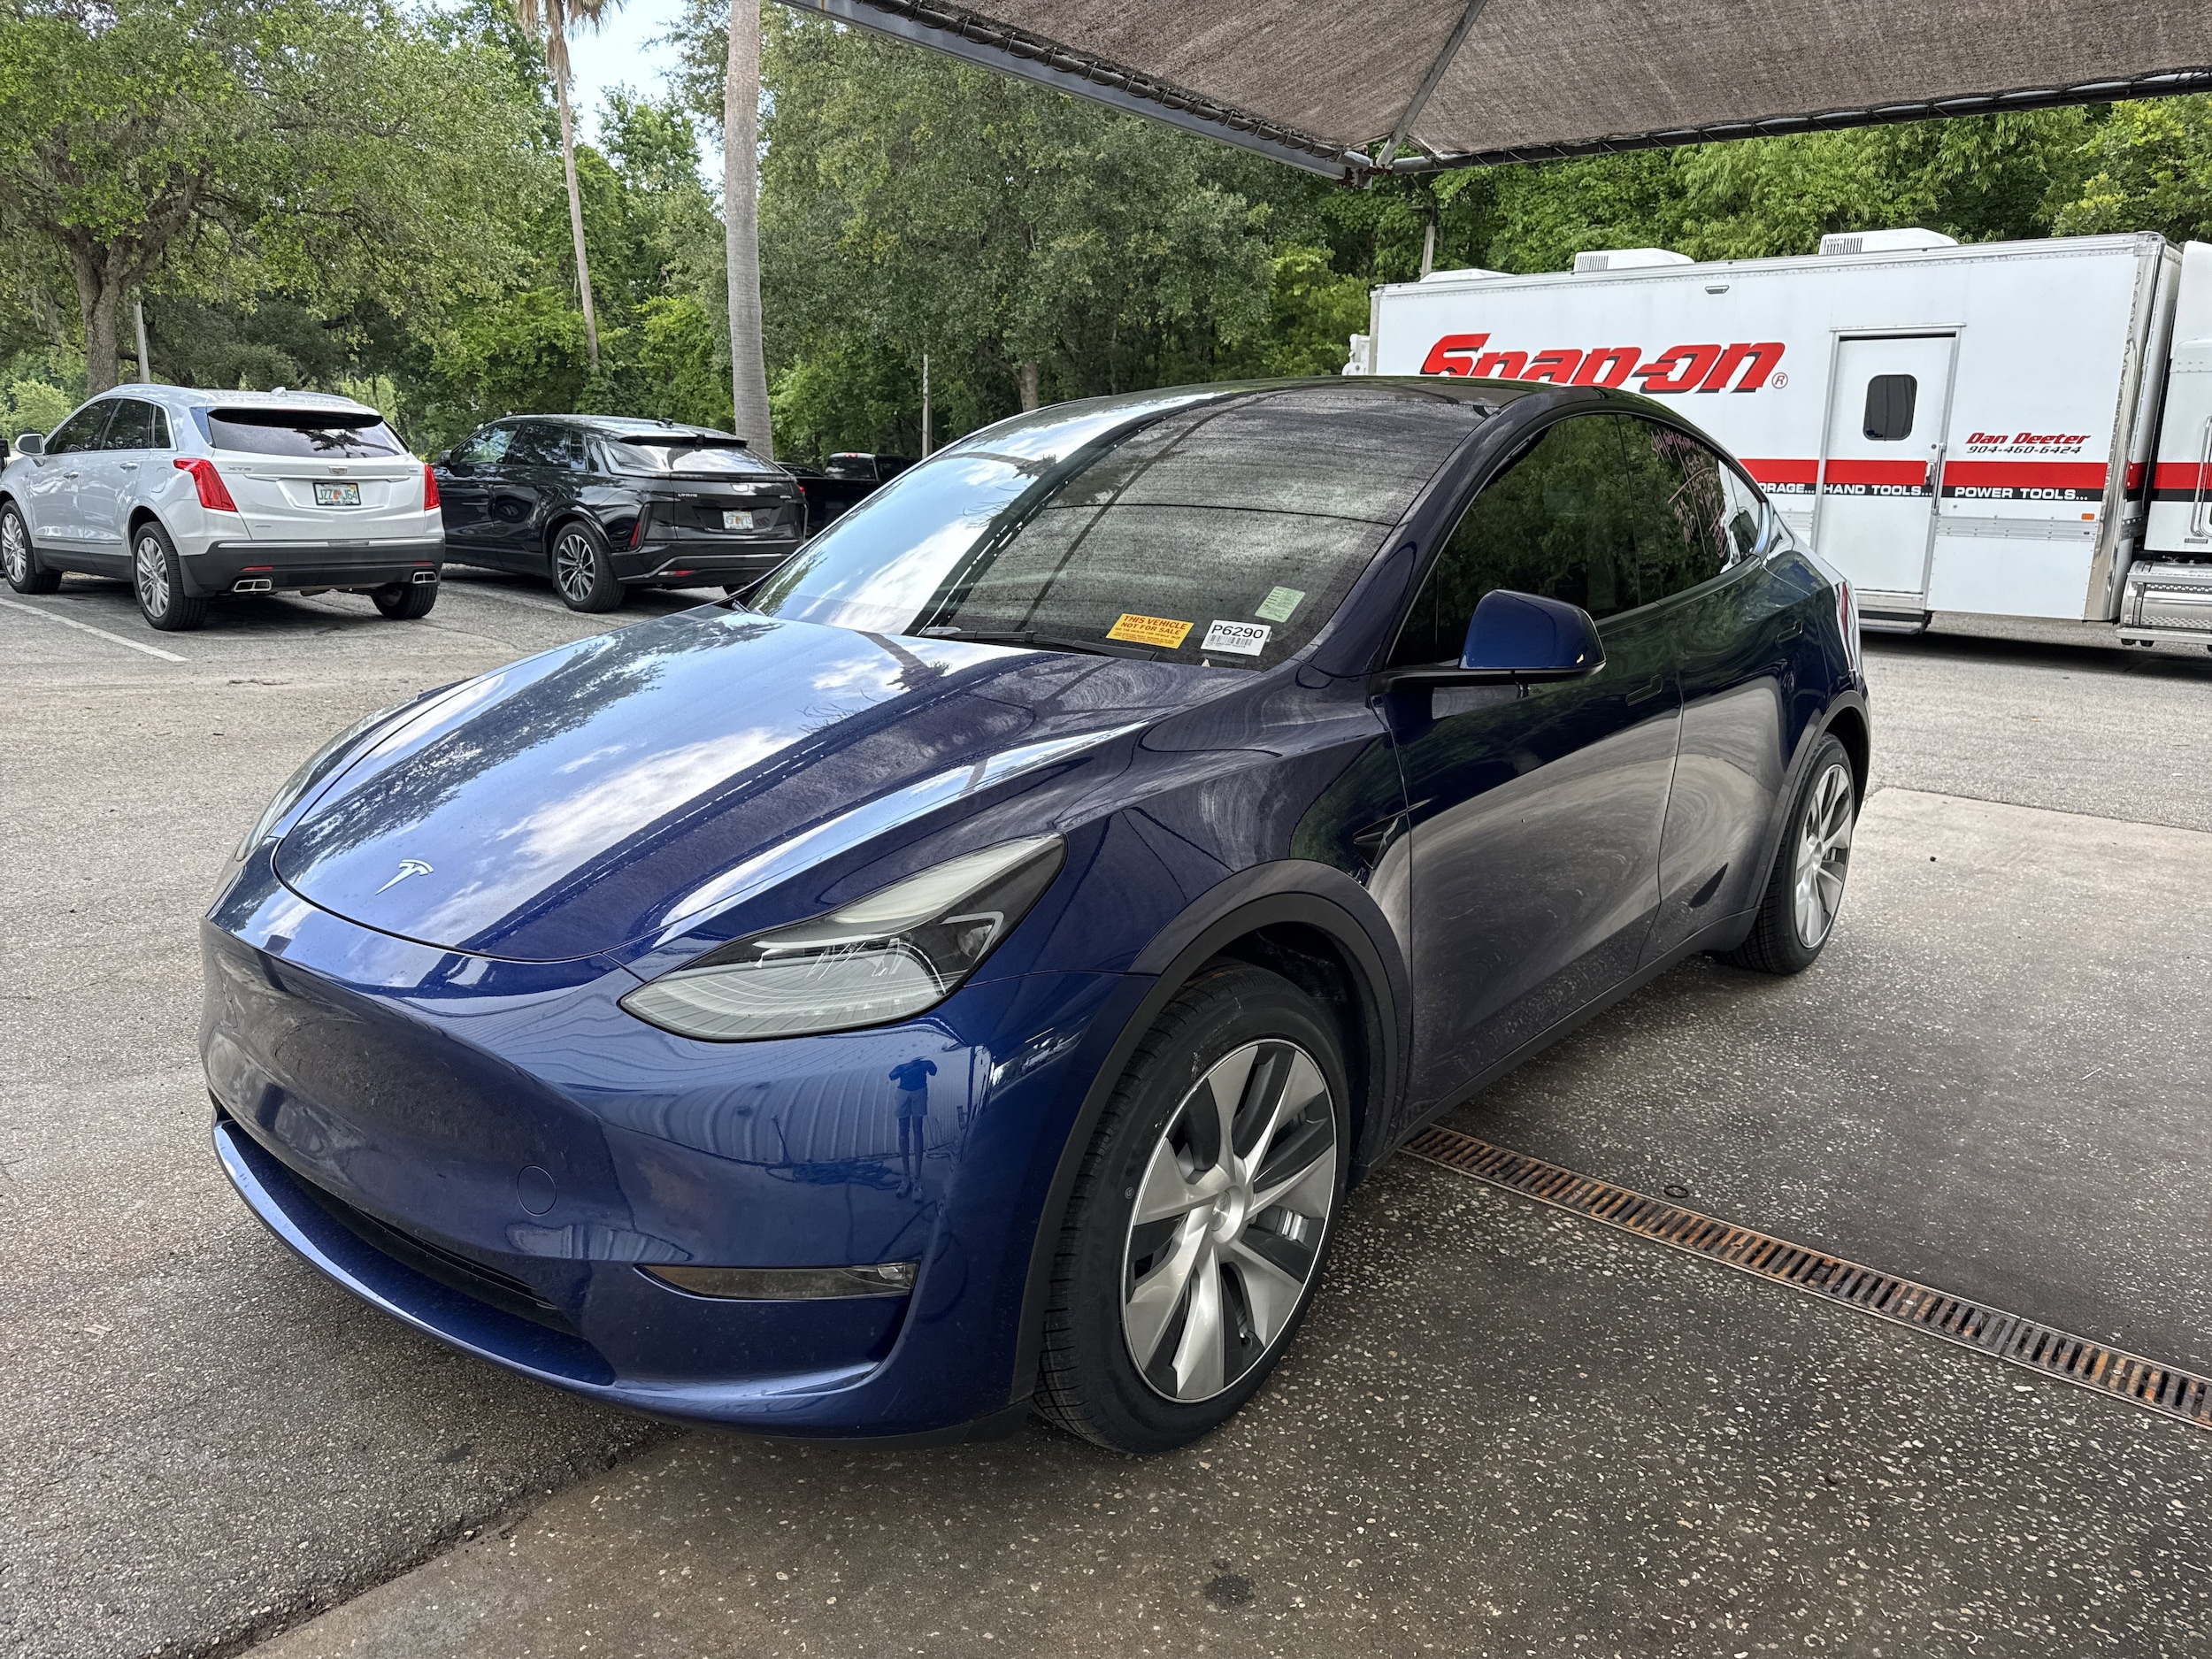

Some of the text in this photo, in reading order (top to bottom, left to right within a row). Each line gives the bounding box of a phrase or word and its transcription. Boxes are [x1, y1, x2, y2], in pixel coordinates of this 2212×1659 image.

[1420, 332, 1786, 394] Snap-on
[1965, 432, 2091, 444] Dan Deeter
[1966, 445, 2082, 454] 904-460-6424
[1823, 484, 1866, 495] HAND
[1870, 485, 1932, 495] TOOLS...
[1954, 487, 2014, 498] POWER
[2019, 488, 2088, 500] TOOLS...
[1124, 615, 1188, 630] THIS VEHICLE
[1210, 624, 1264, 639] P6290
